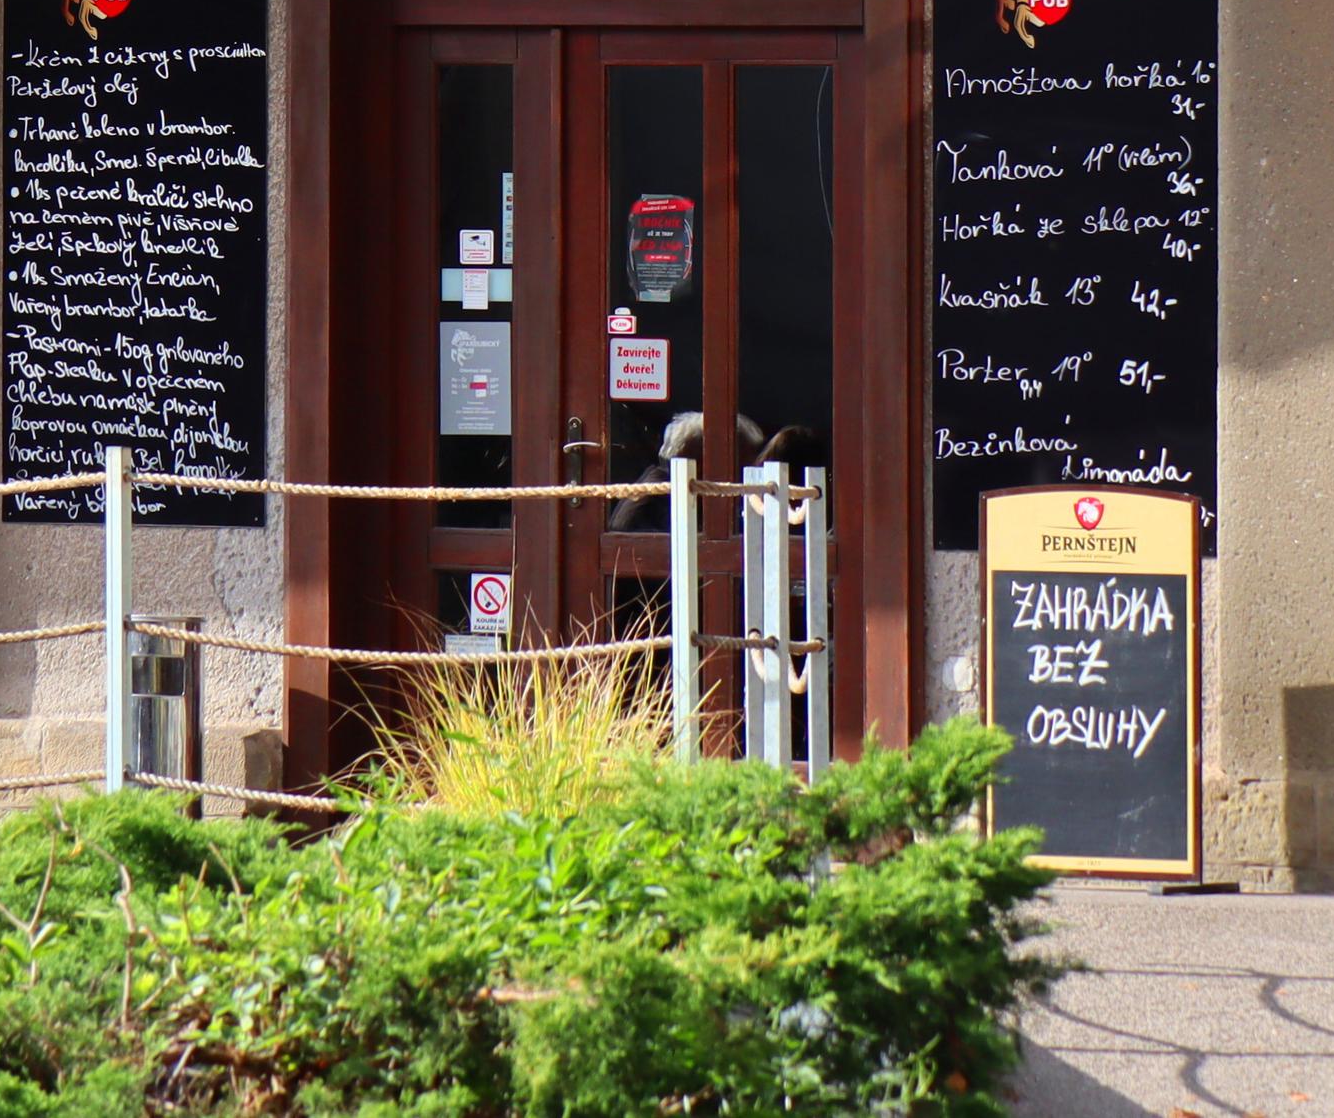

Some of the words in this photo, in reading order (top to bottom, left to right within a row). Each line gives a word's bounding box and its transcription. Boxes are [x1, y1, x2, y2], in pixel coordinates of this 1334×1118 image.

[104, 72, 140, 105] olej
[1105, 60, 1186, 90] hořká
[81, 111, 140, 138] koleno
[936, 139, 1064, 184] Tanková
[9, 210, 36, 225] na
[941, 203, 1025, 242] Hořká
[1080, 206, 1170, 235] sklepa
[939, 272, 1049, 309] Kvasňák
[143, 296, 218, 322] tatarka
[155, 336, 244, 374] grilovaného
[617, 345, 661, 361] Zavírejte
[623, 362, 654, 375] dveře!
[936, 347, 1028, 383] Porter
[616, 379, 661, 393] Děkujeme
[11, 403, 88, 440] koprovou
[934, 414, 1078, 459] Bezinková
[1061, 447, 1192, 484] Limonáda
[1041, 533, 1137, 556] PERNŠTEJN
[1010, 577, 1174, 636] ZAHRÁDKA
[1026, 704, 1167, 759] OBSLUHY
